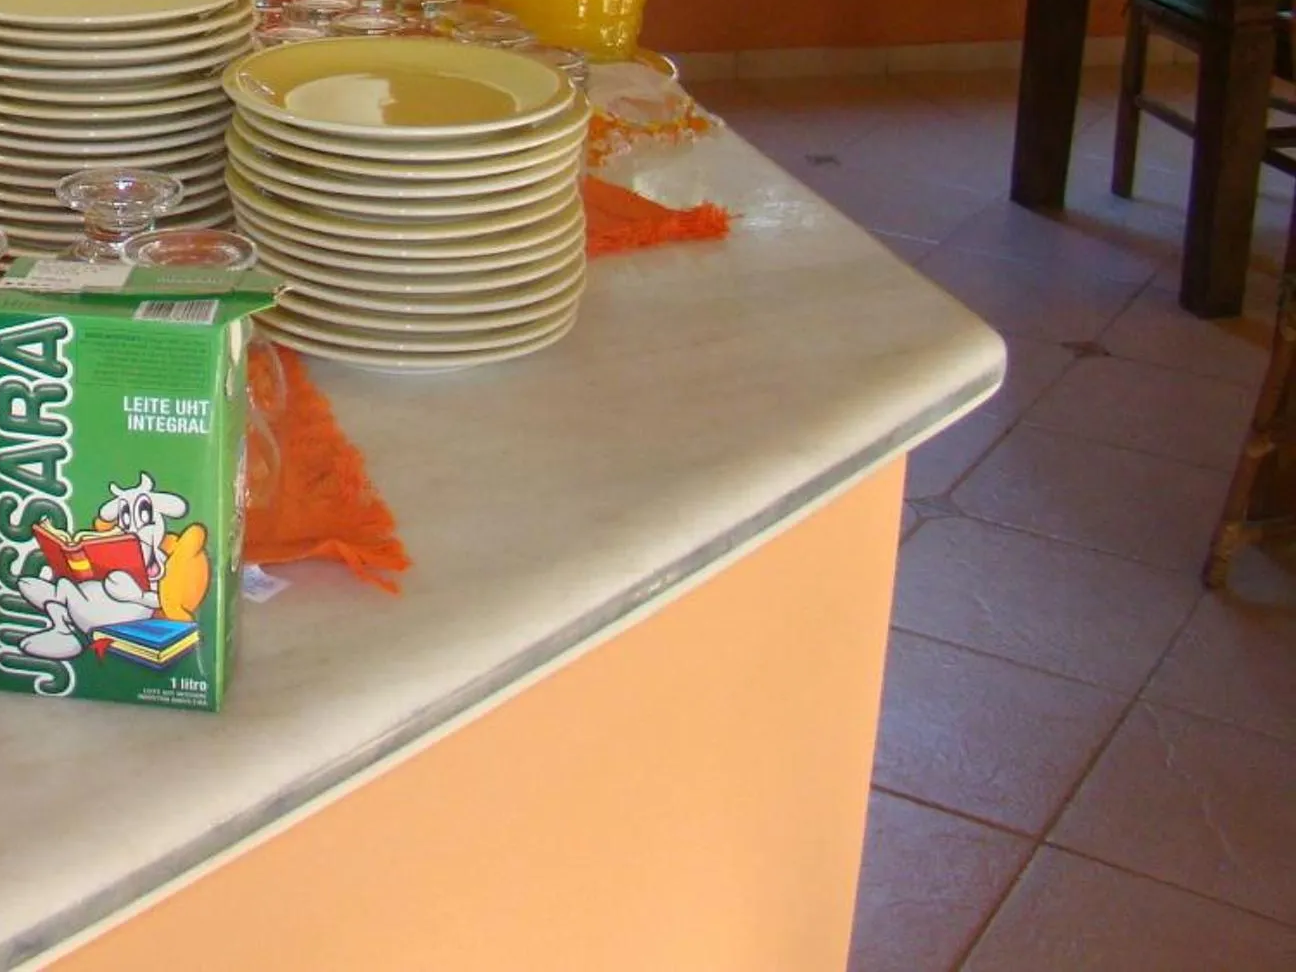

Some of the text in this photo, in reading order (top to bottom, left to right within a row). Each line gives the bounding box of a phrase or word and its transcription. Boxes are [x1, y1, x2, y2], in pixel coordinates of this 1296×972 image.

[123, 396, 210, 416] LEITE UHT
[127, 414, 210, 434] INTEGRAL
[169, 676, 207, 692] 1 litro
